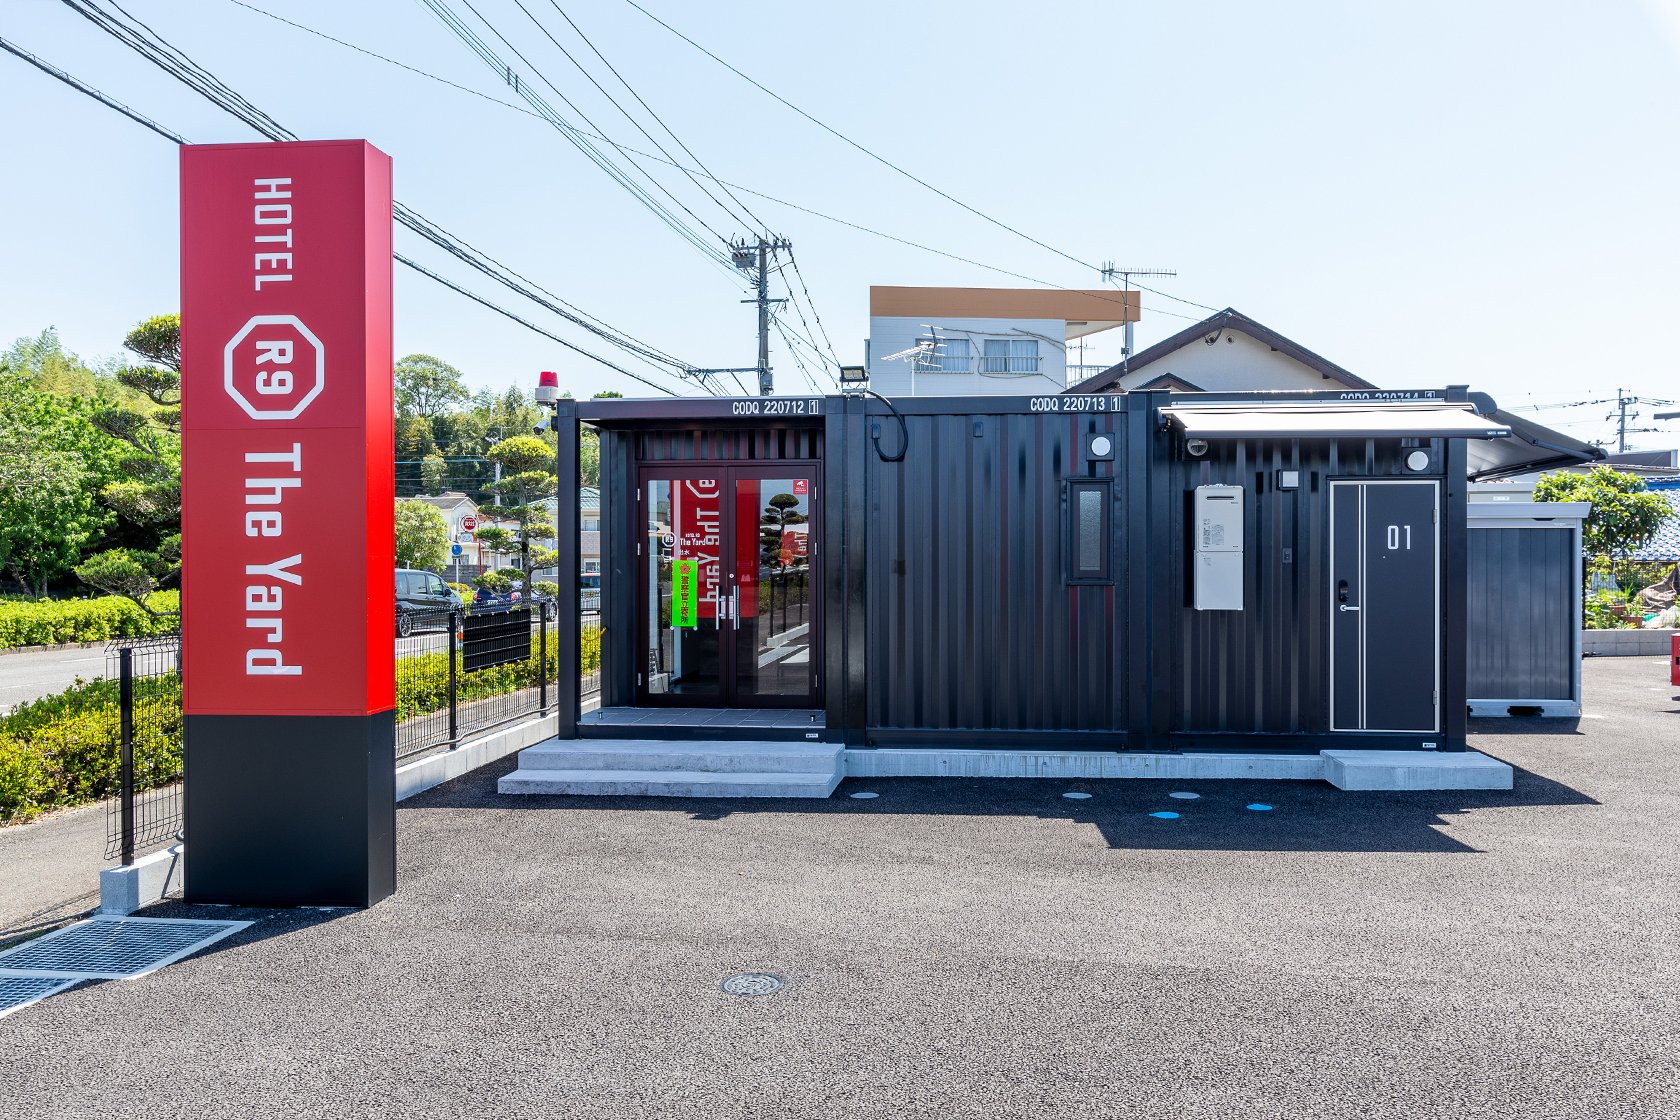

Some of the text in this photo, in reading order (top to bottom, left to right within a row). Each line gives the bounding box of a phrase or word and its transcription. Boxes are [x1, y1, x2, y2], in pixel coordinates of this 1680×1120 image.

[732, 401, 760, 415] CODQ
[763, 400, 804, 414] 220712
[1030, 397, 1059, 411] CODQ
[1063, 397, 1105, 411] 220713
[244, 177, 303, 676] HOTEL R9 The Yard
[680, 538, 706, 546] The Yard
[1387, 525, 1411, 550] 01
